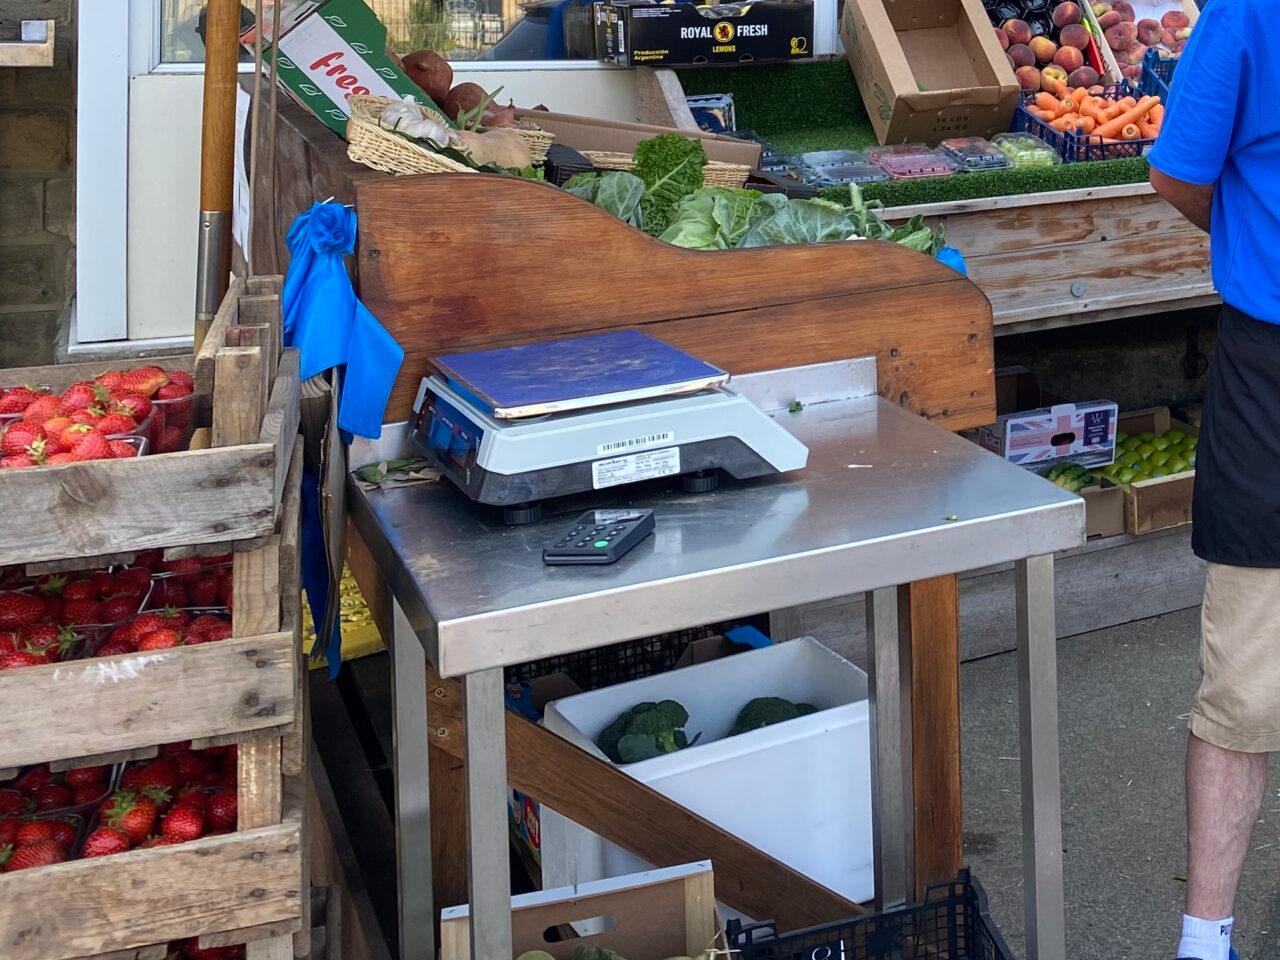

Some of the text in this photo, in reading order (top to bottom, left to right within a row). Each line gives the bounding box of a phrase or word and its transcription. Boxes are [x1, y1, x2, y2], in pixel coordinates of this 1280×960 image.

[681, 24, 768, 39] ROYAL FRESH
[712, 45, 736, 53] LEMONS
